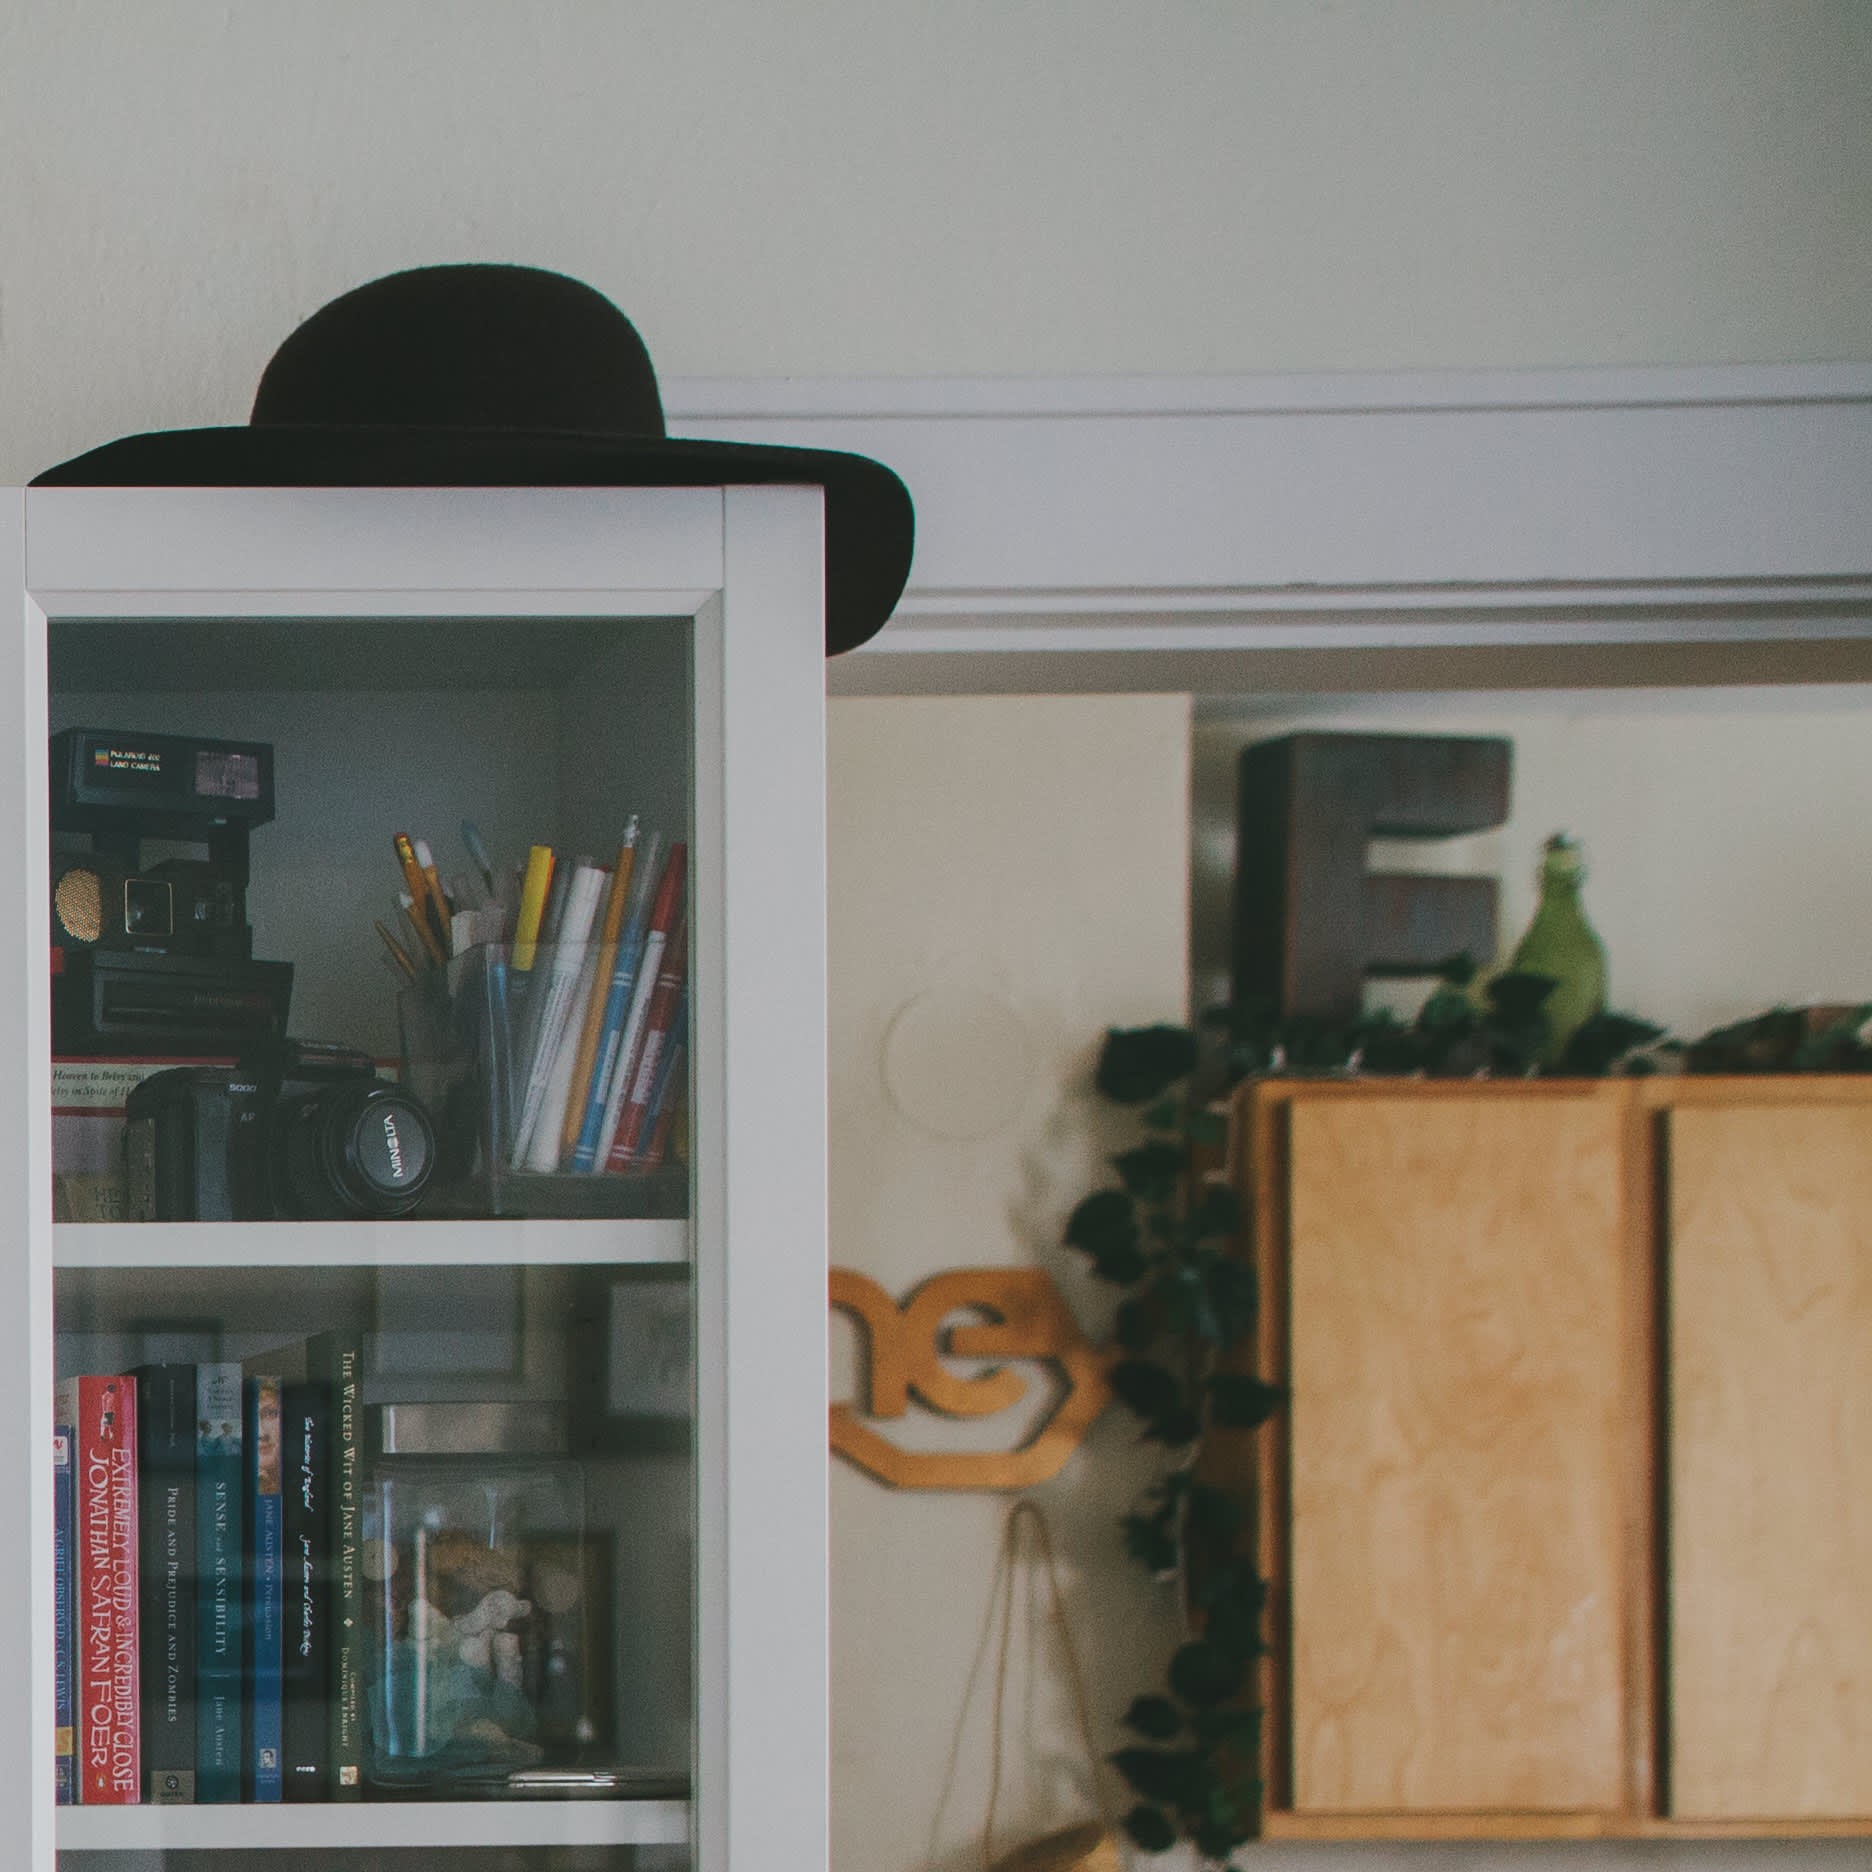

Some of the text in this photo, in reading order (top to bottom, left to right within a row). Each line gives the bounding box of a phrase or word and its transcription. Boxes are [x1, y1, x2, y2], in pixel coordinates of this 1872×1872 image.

[383, 1113, 404, 1178] MINOLTA
[342, 1383, 356, 1441] WICKED
[342, 1446, 356, 1476] WIT
[167, 1487, 180, 1527] PRIDE
[215, 1481, 228, 1532] SENSE
[263, 1499, 275, 1527] JANE
[340, 1504, 356, 1539] JANE
[263, 1529, 275, 1573] AUSTEN
[342, 1543, 356, 1600] AUSTEN
[88, 1447, 112, 1769] JONATHAN SAFRAN FOER
[111, 1447, 134, 1793] EXTREMELY LOUD & INCREDIBLY CLOSE
[215, 1556, 228, 1657] SENSIBILITY
[215, 1726, 226, 1767] Austen
